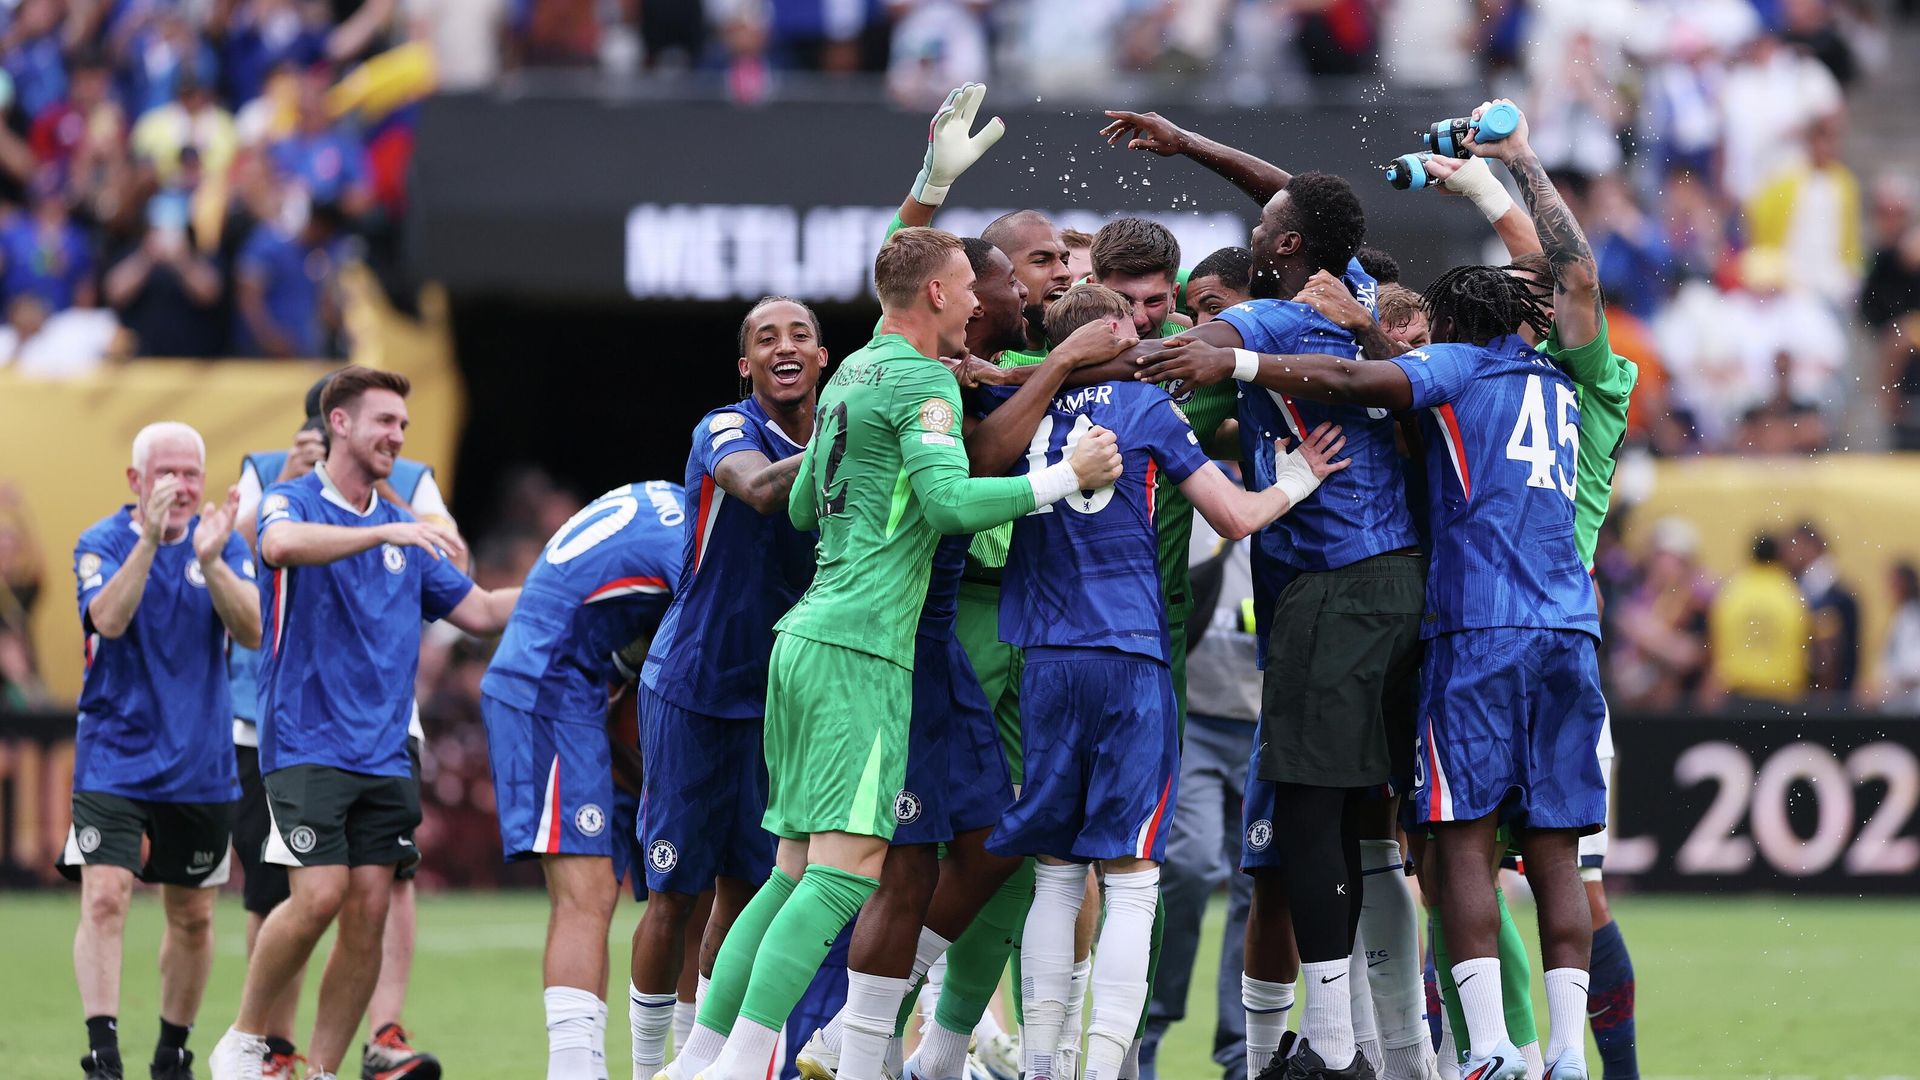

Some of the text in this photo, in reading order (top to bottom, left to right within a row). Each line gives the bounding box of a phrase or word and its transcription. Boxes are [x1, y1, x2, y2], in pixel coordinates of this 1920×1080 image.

[1506, 373, 1580, 501] 45
[546, 484, 638, 565] 0
[1675, 740, 1920, 876] 202
[1336, 884, 1346, 895] K
